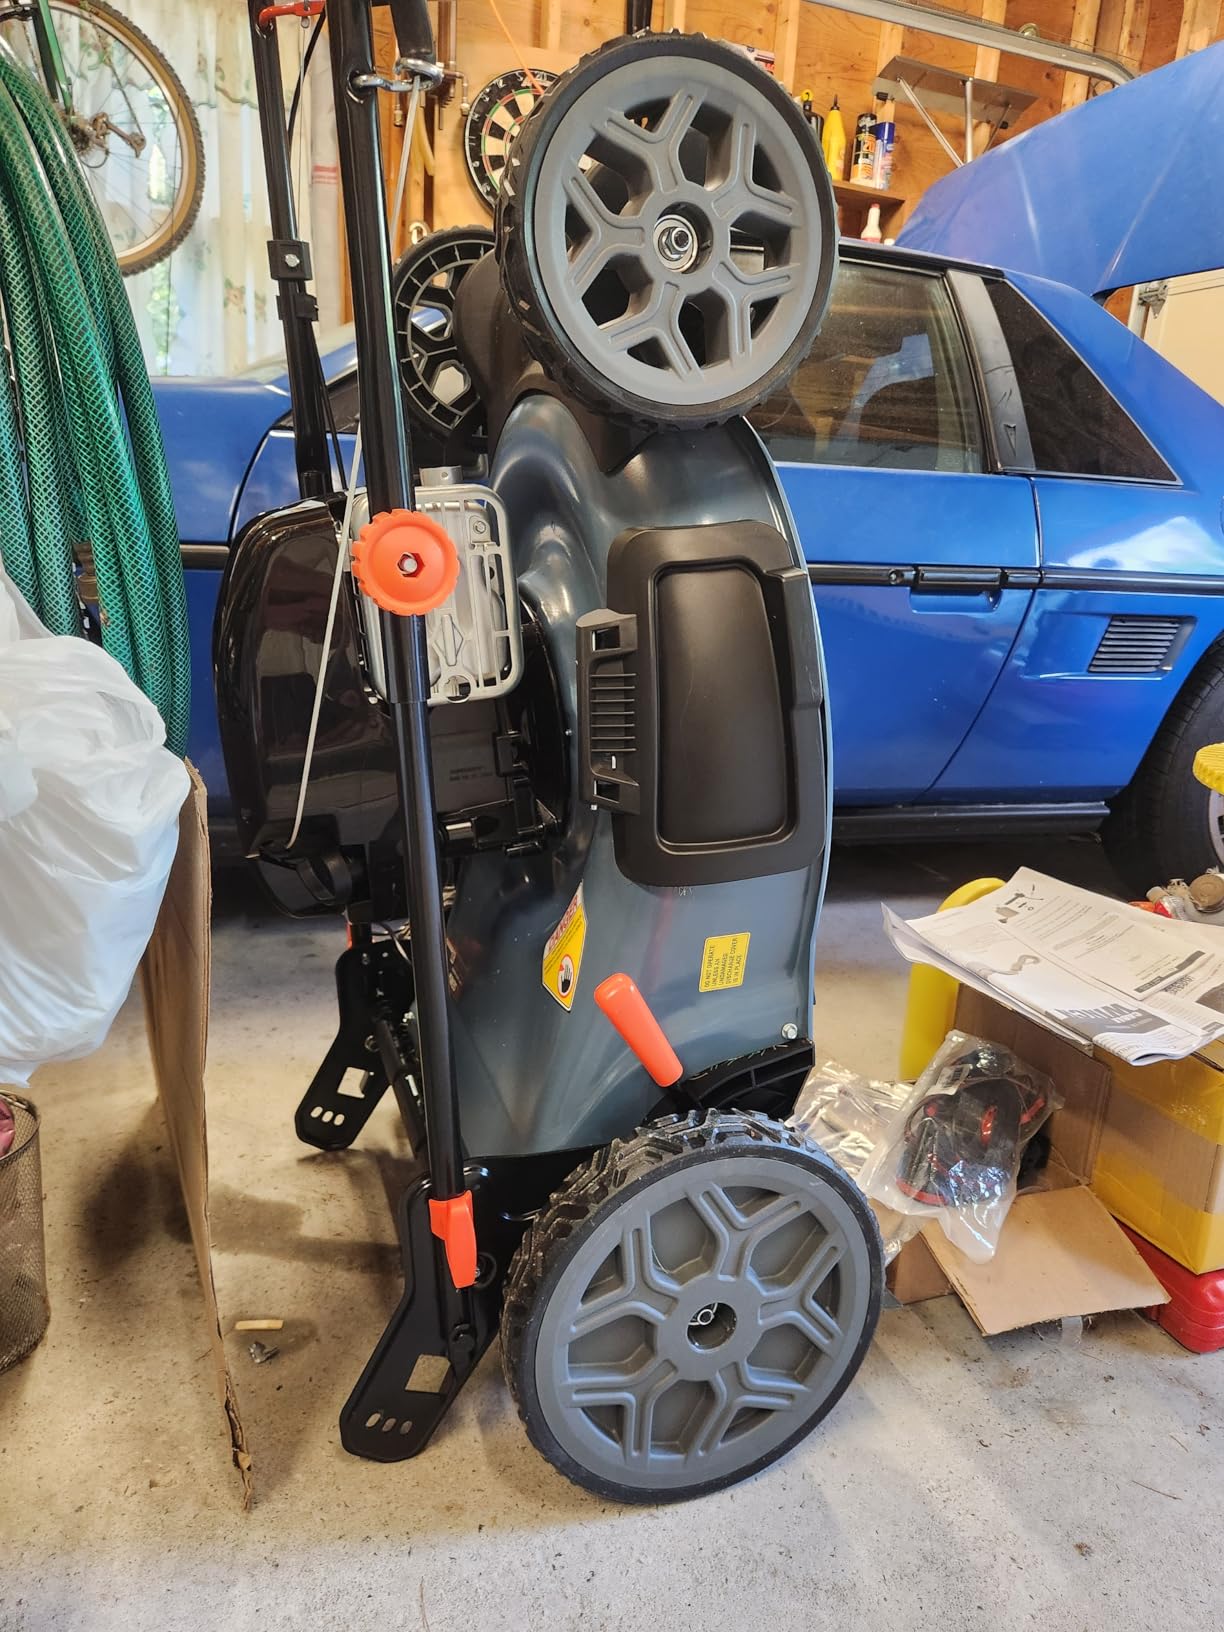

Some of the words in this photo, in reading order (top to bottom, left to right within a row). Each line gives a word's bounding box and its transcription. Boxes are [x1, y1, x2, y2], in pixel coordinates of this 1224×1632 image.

[707, 945, 715, 969] OPERATE
[718, 952, 728, 986] UNDAMAGED
[725, 955, 735, 985] DISCHARGE
[730, 937, 738, 955] COVER
[711, 966, 719, 987] UNLESS
